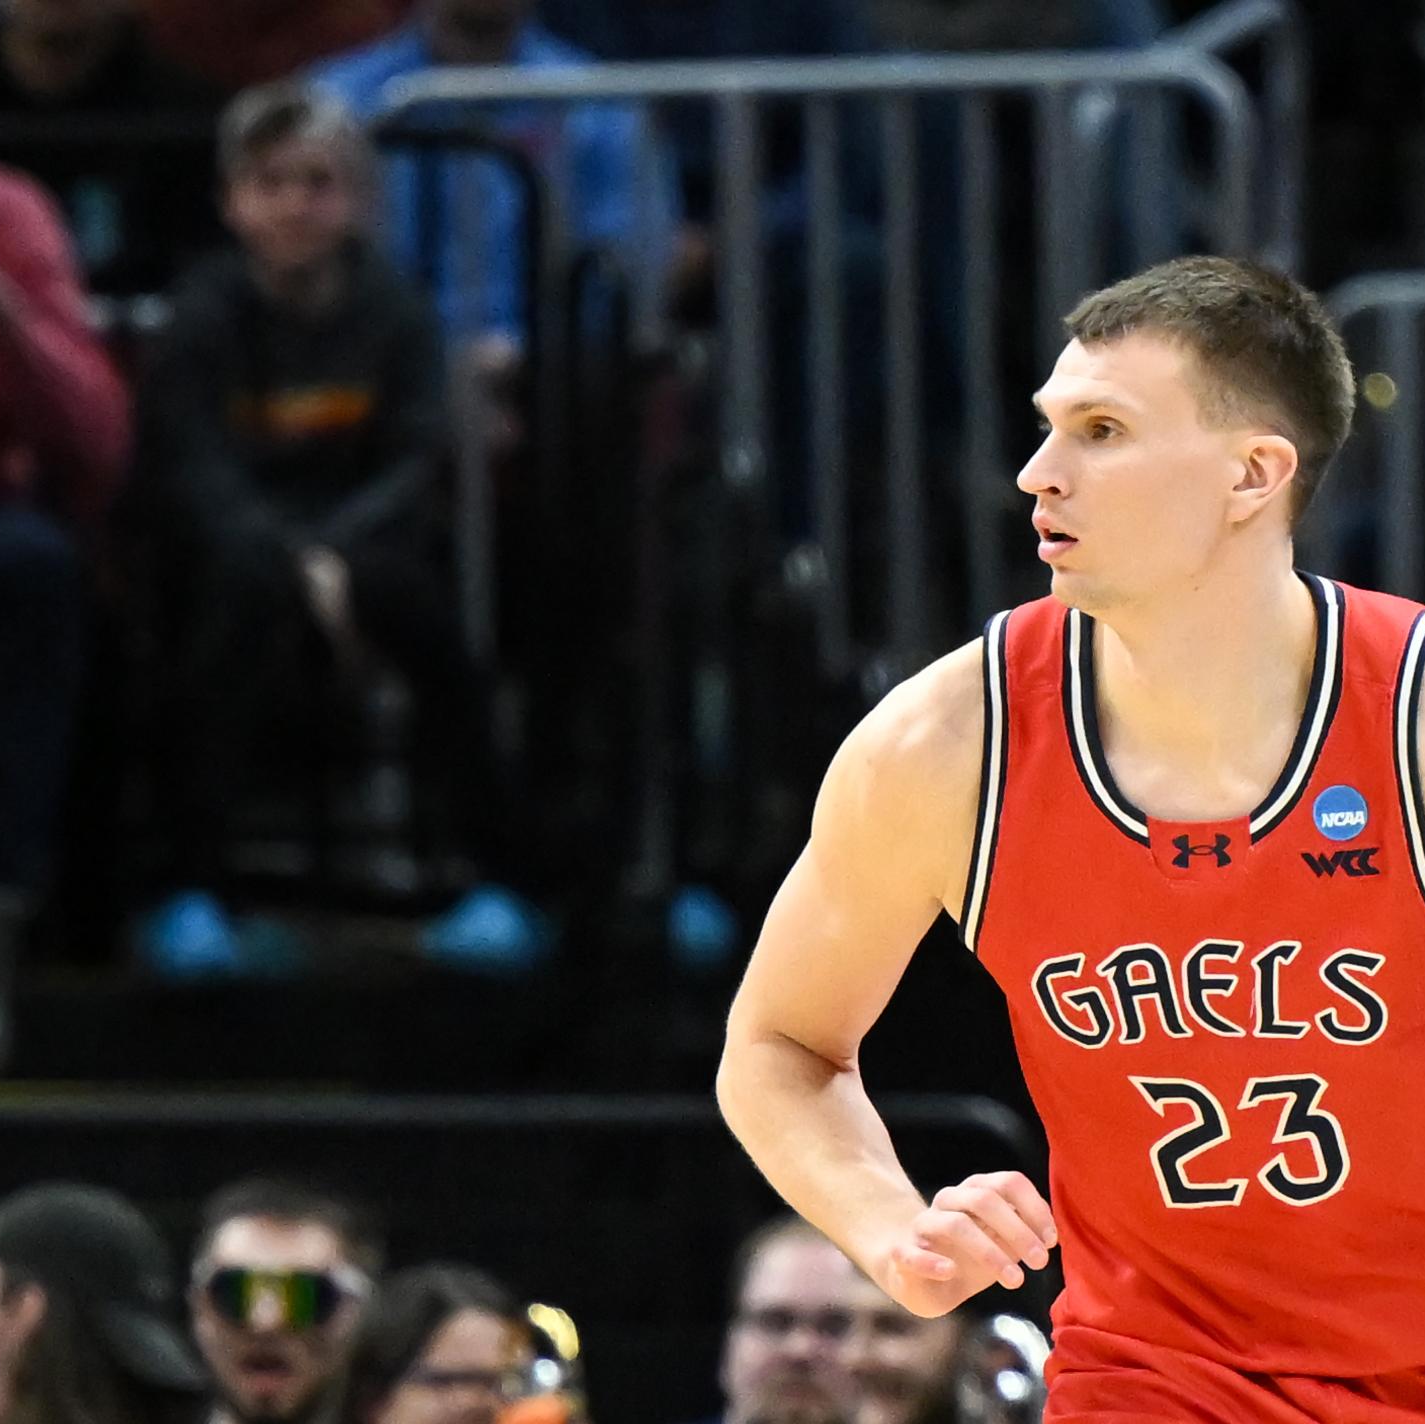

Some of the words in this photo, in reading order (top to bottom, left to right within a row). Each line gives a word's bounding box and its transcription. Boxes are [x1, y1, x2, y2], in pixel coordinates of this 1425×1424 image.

[1321, 811, 1365, 828] NCAA
[1300, 847, 1380, 878] WCC
[1031, 938, 1388, 1050] GAELS
[1128, 1073, 1350, 1209] 23
